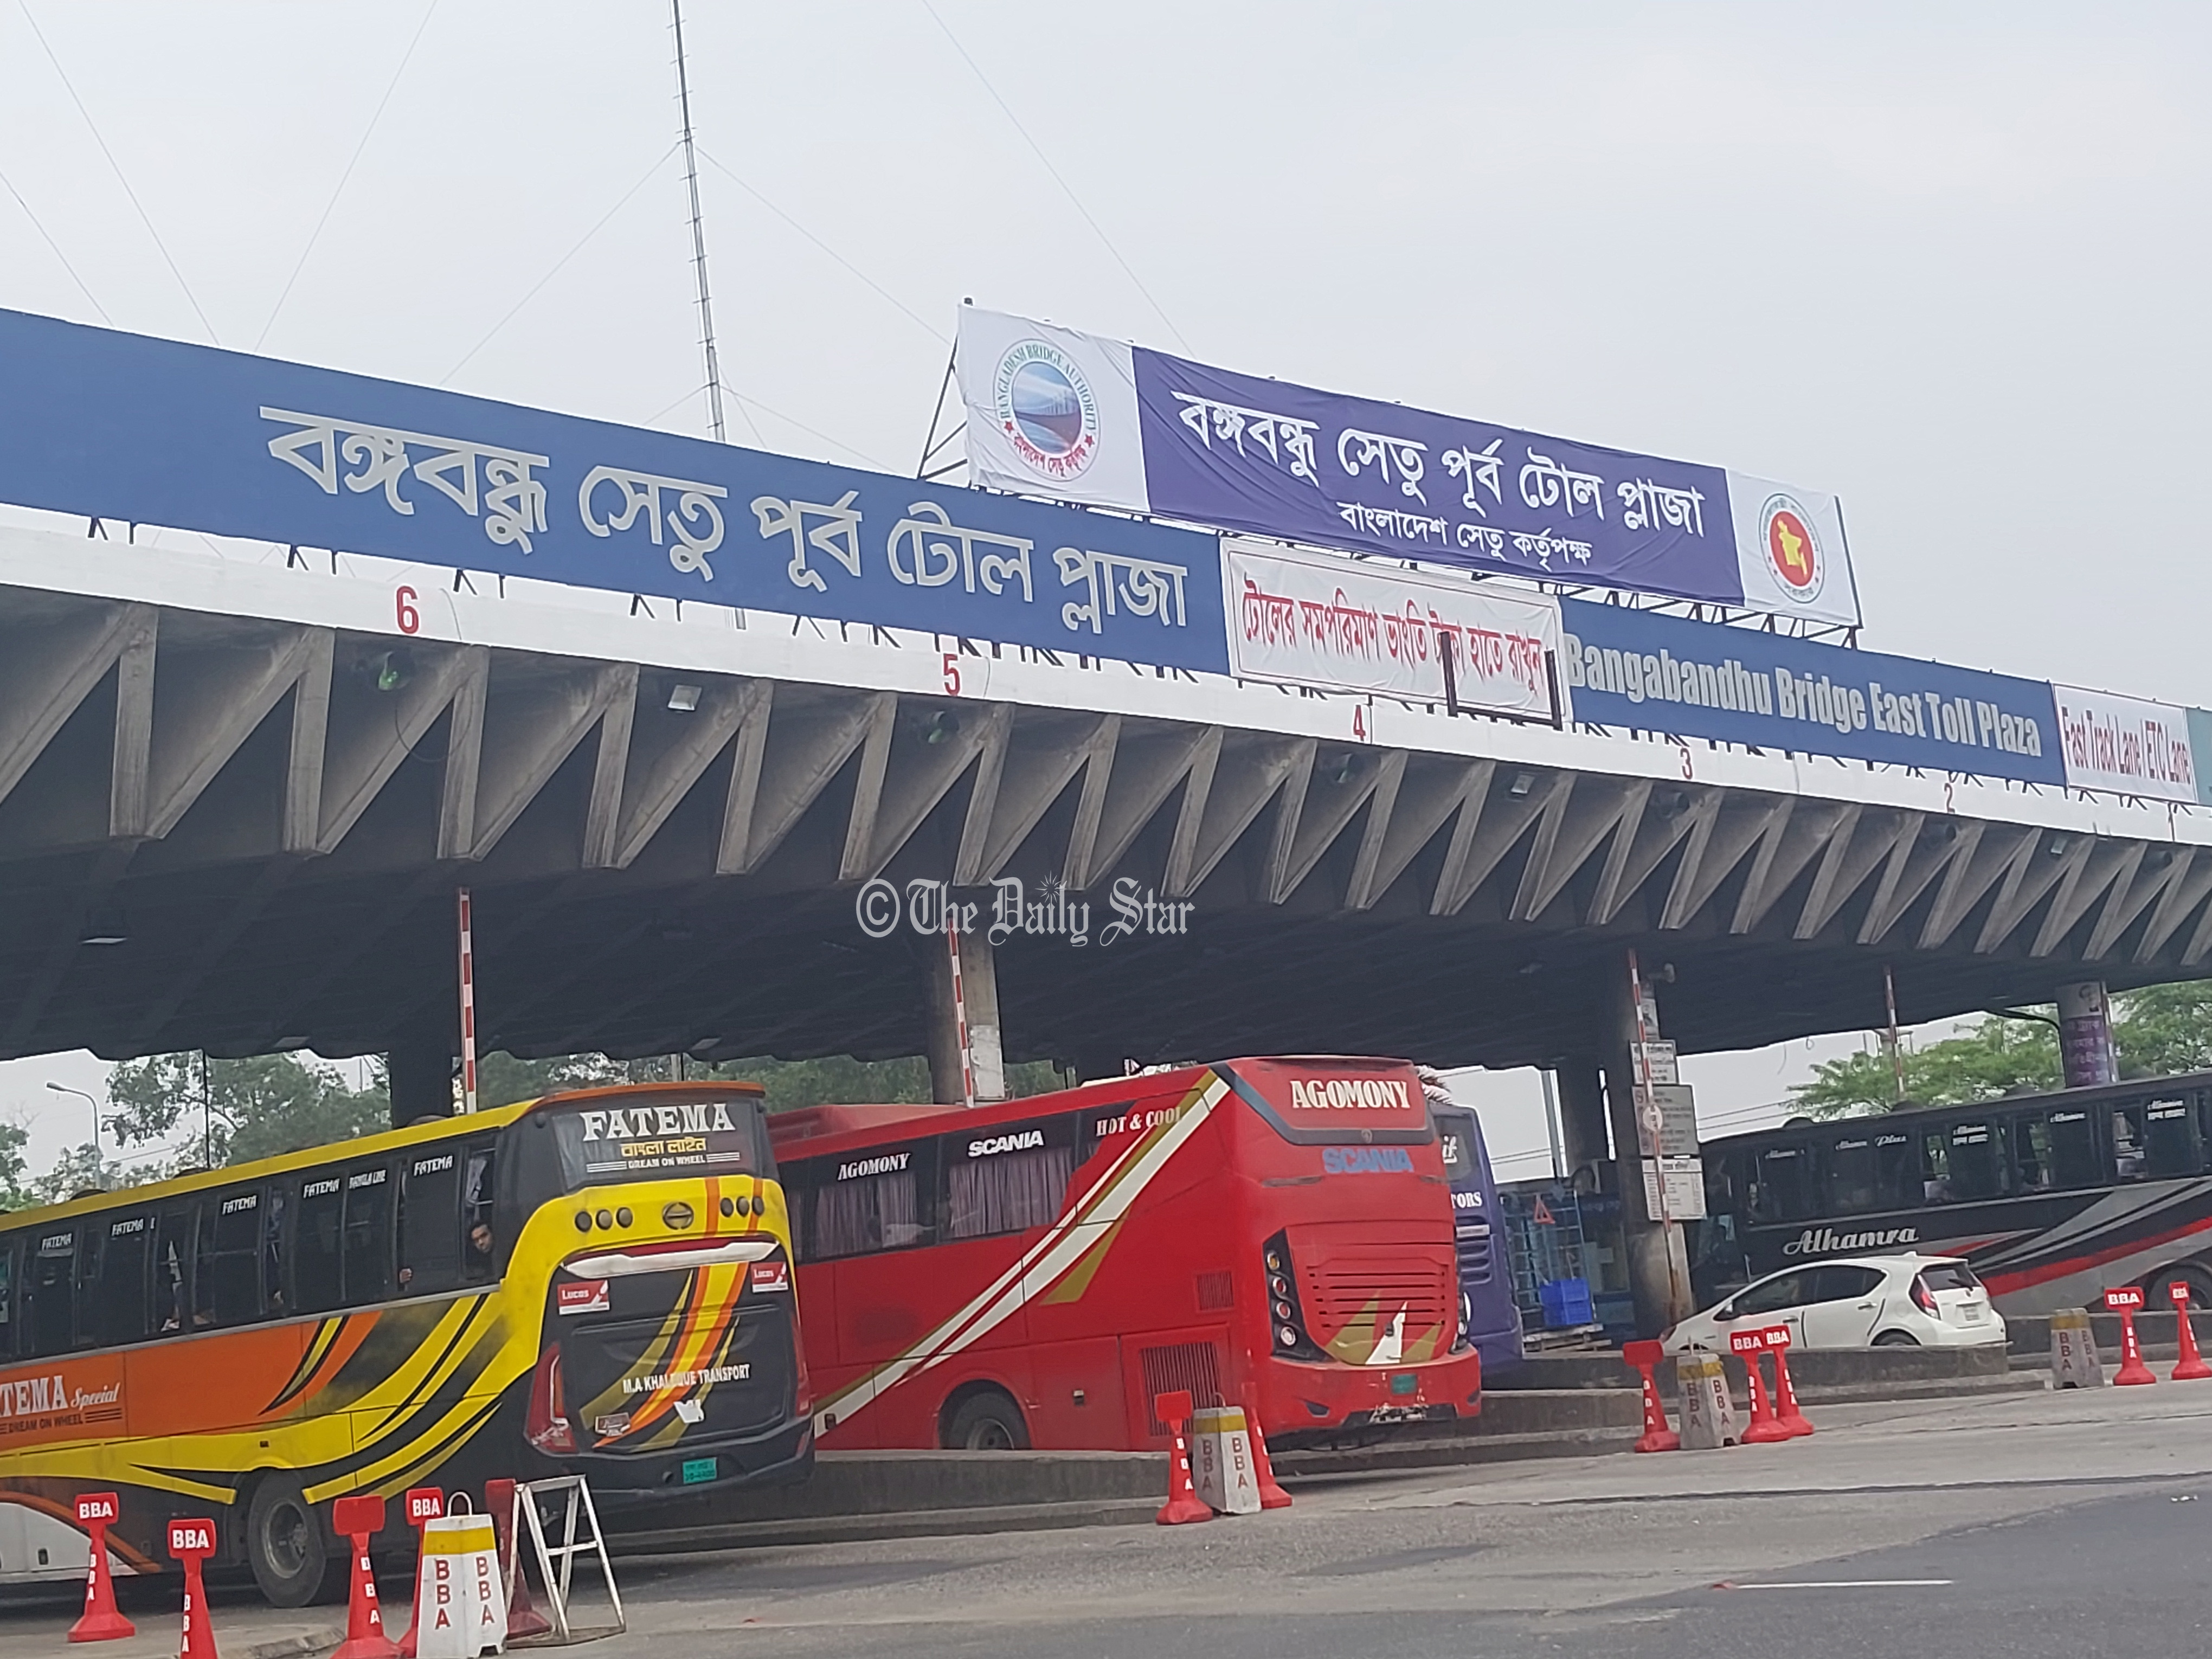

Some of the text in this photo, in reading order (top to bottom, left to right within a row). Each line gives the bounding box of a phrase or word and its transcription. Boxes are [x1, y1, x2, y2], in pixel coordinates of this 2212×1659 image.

[998, 344, 1096, 430] BANGLADESH BRIDGE AUTHORITY
[1170, 389, 1321, 488] বঙ্গবন্ধু
[1337, 427, 1429, 507] সেতু
[1441, 438, 1504, 519] পূর্ব
[1519, 446, 1605, 521] টোল
[1616, 477, 1706, 538] প্লাজা
[259, 405, 1188, 636] বঙ্গবন্ধু সেতু পূর্ব টোল প্লাজা
[1336, 501, 1593, 573] বাংলাদেশ সেতু কর্তৃপক্ষ
[396, 586, 419, 634] 6
[1242, 571, 1544, 697] টোলের সমপরিমাণ ভাংতি টকা হাতে রাখুন
[943, 652, 961, 698] 5
[1564, 632, 2043, 758] Bangabandhu Bridge East Toll Plaza
[1353, 704, 1366, 742] 4
[2061, 706, 2089, 769] Fast
[2086, 709, 2118, 773] Track
[2114, 715, 2143, 778] Lane
[2144, 719, 2166, 782] ETC
[2164, 724, 2191, 786] Lane
[1679, 747, 1693, 780] 3
[1944, 782, 1956, 814] 2
[1289, 1079, 1411, 1110] AGOMONY
[579, 1103, 737, 1142] FATEMA
[1096, 1116, 1127, 1137] HOT
[1129, 1113, 1143, 1130] &
[619, 1136, 707, 1158] বাংলা লাইন
[967, 1129, 1045, 1158] SCANIA
[413, 1154, 454, 1177] FATEMA
[628, 1154, 706, 1170] DREAM ON WHEEL
[837, 1152, 912, 1181] AGOMONY
[1322, 1147, 1414, 1174] SCANIA
[303, 1178, 340, 1199] FATEMA
[222, 1194, 257, 1216] FATEMA
[1783, 1226, 1920, 1255] Alhamra
[2107, 1293, 2140, 1305] BBA
[1733, 1335, 1763, 1351] BBA
[1765, 1330, 1790, 1345] BBA
[2059, 1332, 2073, 1371] BBA
[643, 1370, 697, 1392] KHALUE
[698, 1364, 750, 1384] TRANSPORT
[0, 1375, 121, 1418] TEMA Special
[1687, 1382, 1701, 1429] BBA
[1713, 1379, 1729, 1425] BBA
[8, 1413, 83, 1433] DREAM ON WHEEL
[1201, 1439, 1214, 1491] BBA
[1231, 1437, 1249, 1489] BBA
[79, 1502, 113, 1519] BBA
[412, 1497, 441, 1517] BBA
[171, 1529, 210, 1549] BBA
[434, 1558, 451, 1630] BBA
[475, 1555, 495, 1626] BBA
